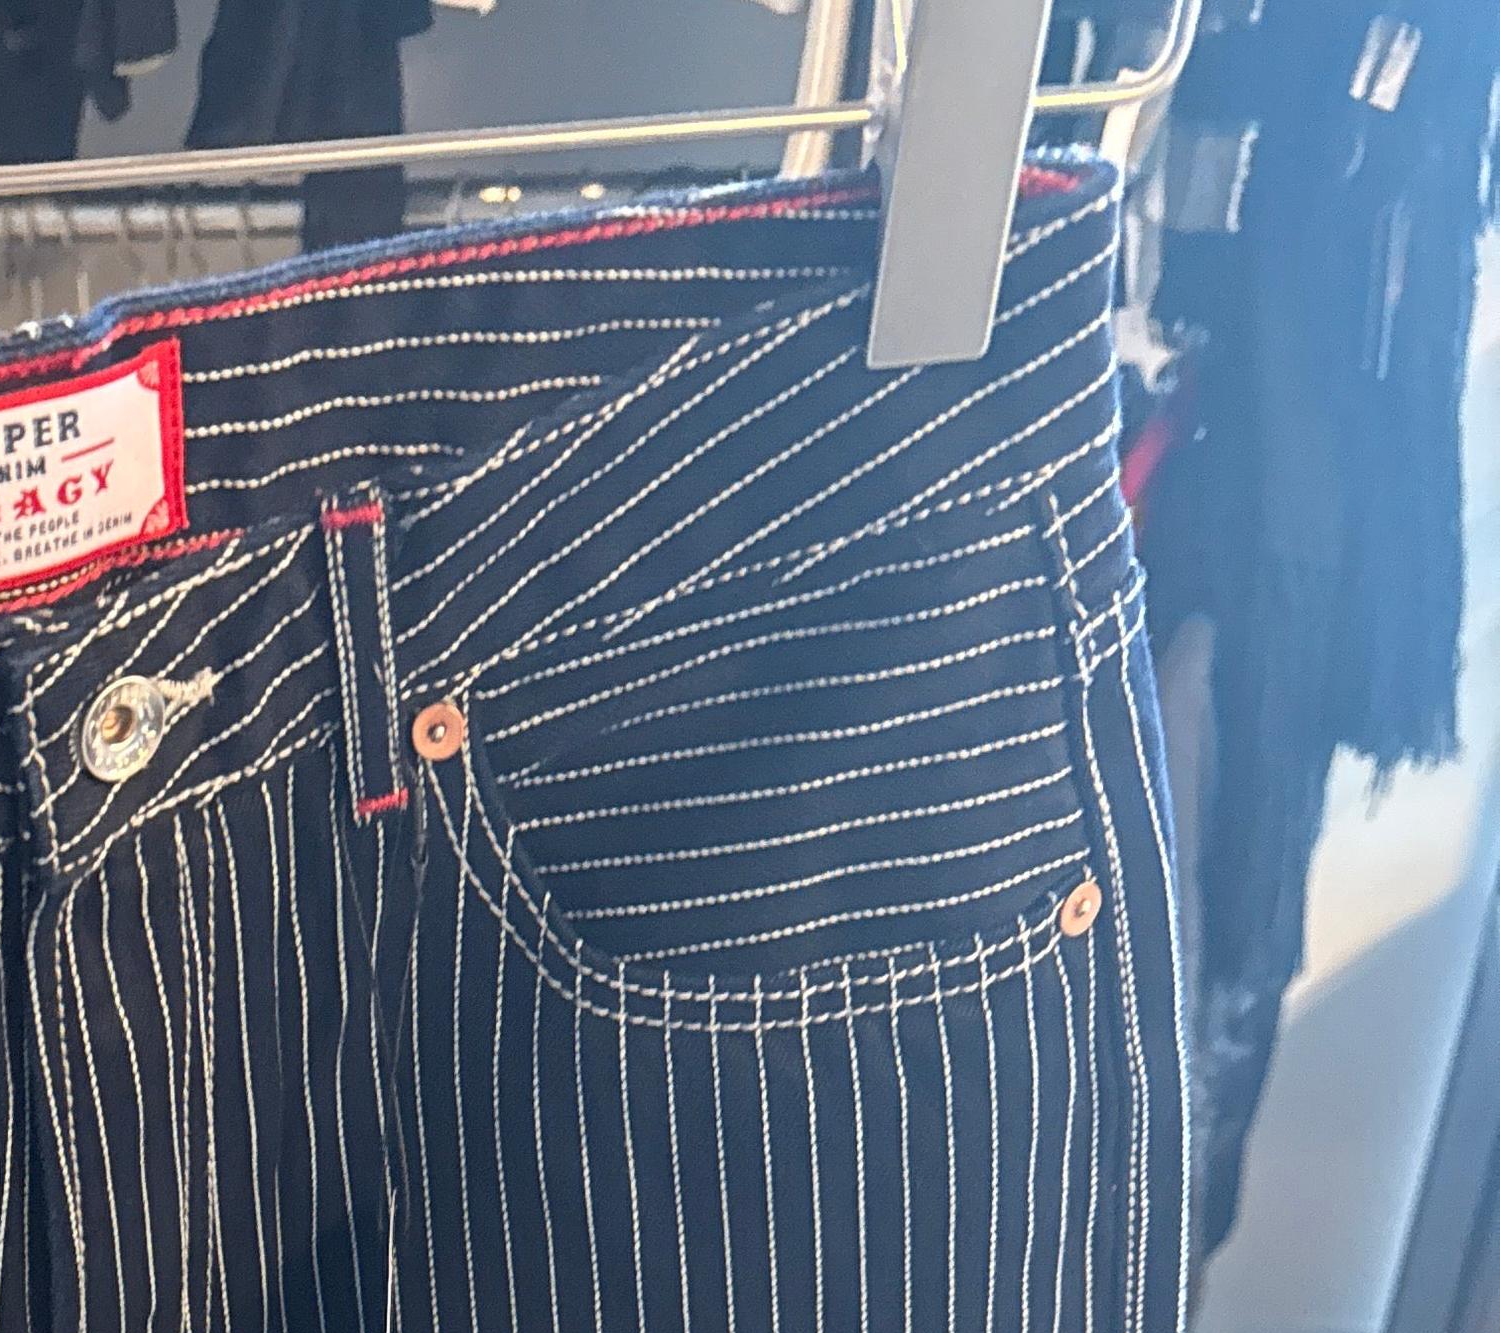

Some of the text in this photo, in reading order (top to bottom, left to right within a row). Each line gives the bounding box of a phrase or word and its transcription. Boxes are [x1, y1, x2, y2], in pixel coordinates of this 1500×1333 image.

[13, 530, 78, 563] BREATHE
[97, 511, 133, 536] DENIM
[29, 510, 80, 538] PEOPLE
